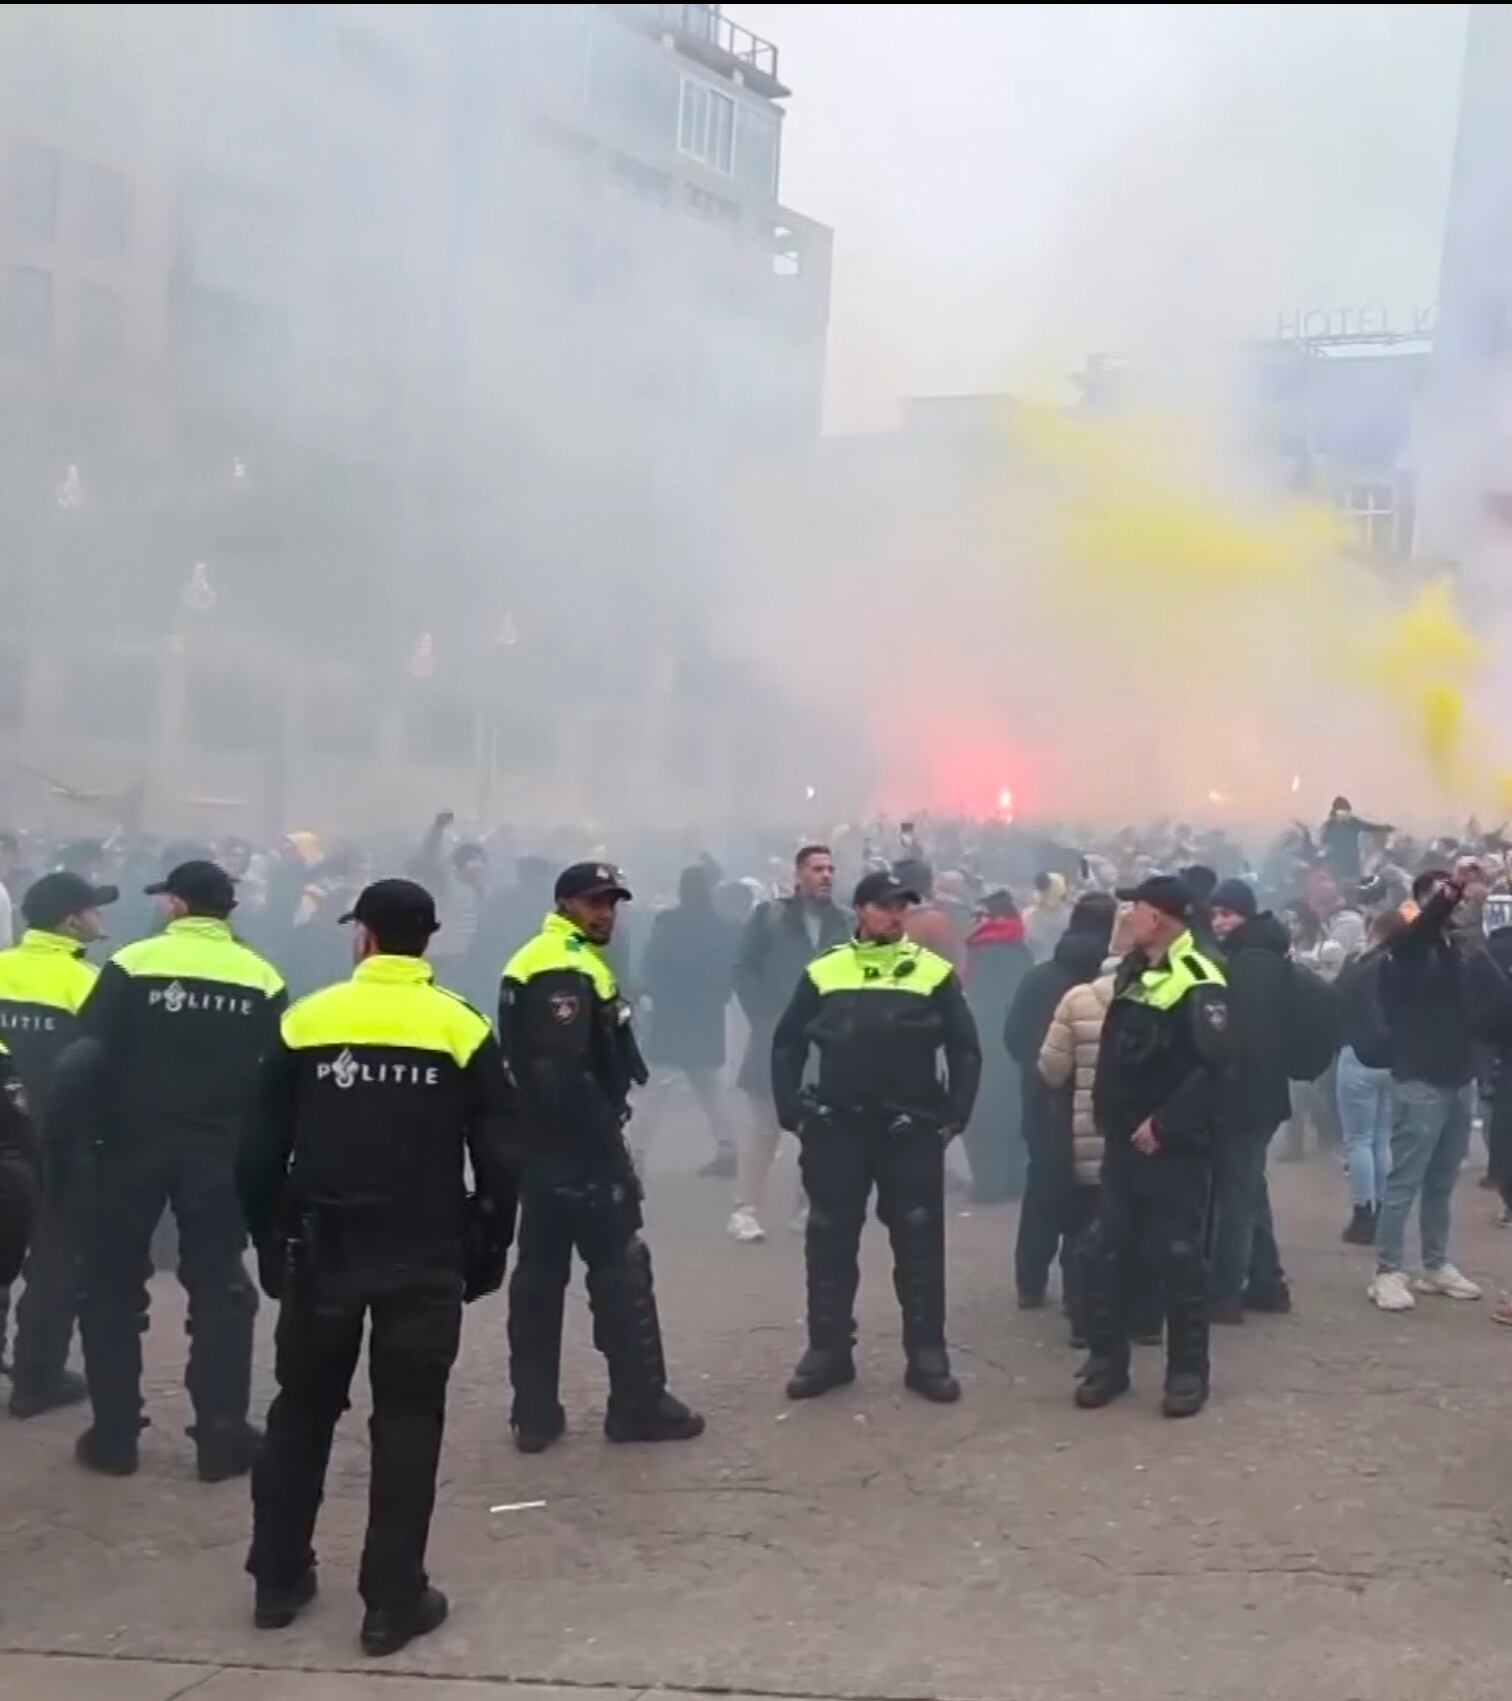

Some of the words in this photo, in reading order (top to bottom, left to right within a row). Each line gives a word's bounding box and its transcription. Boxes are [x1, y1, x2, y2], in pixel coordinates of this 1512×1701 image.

[1277, 305, 1397, 340] HOTEL
[148, 984, 253, 1015] POLITIE
[1, 1012, 56, 1032] LITIE
[316, 1055, 440, 1088] POLITIE
